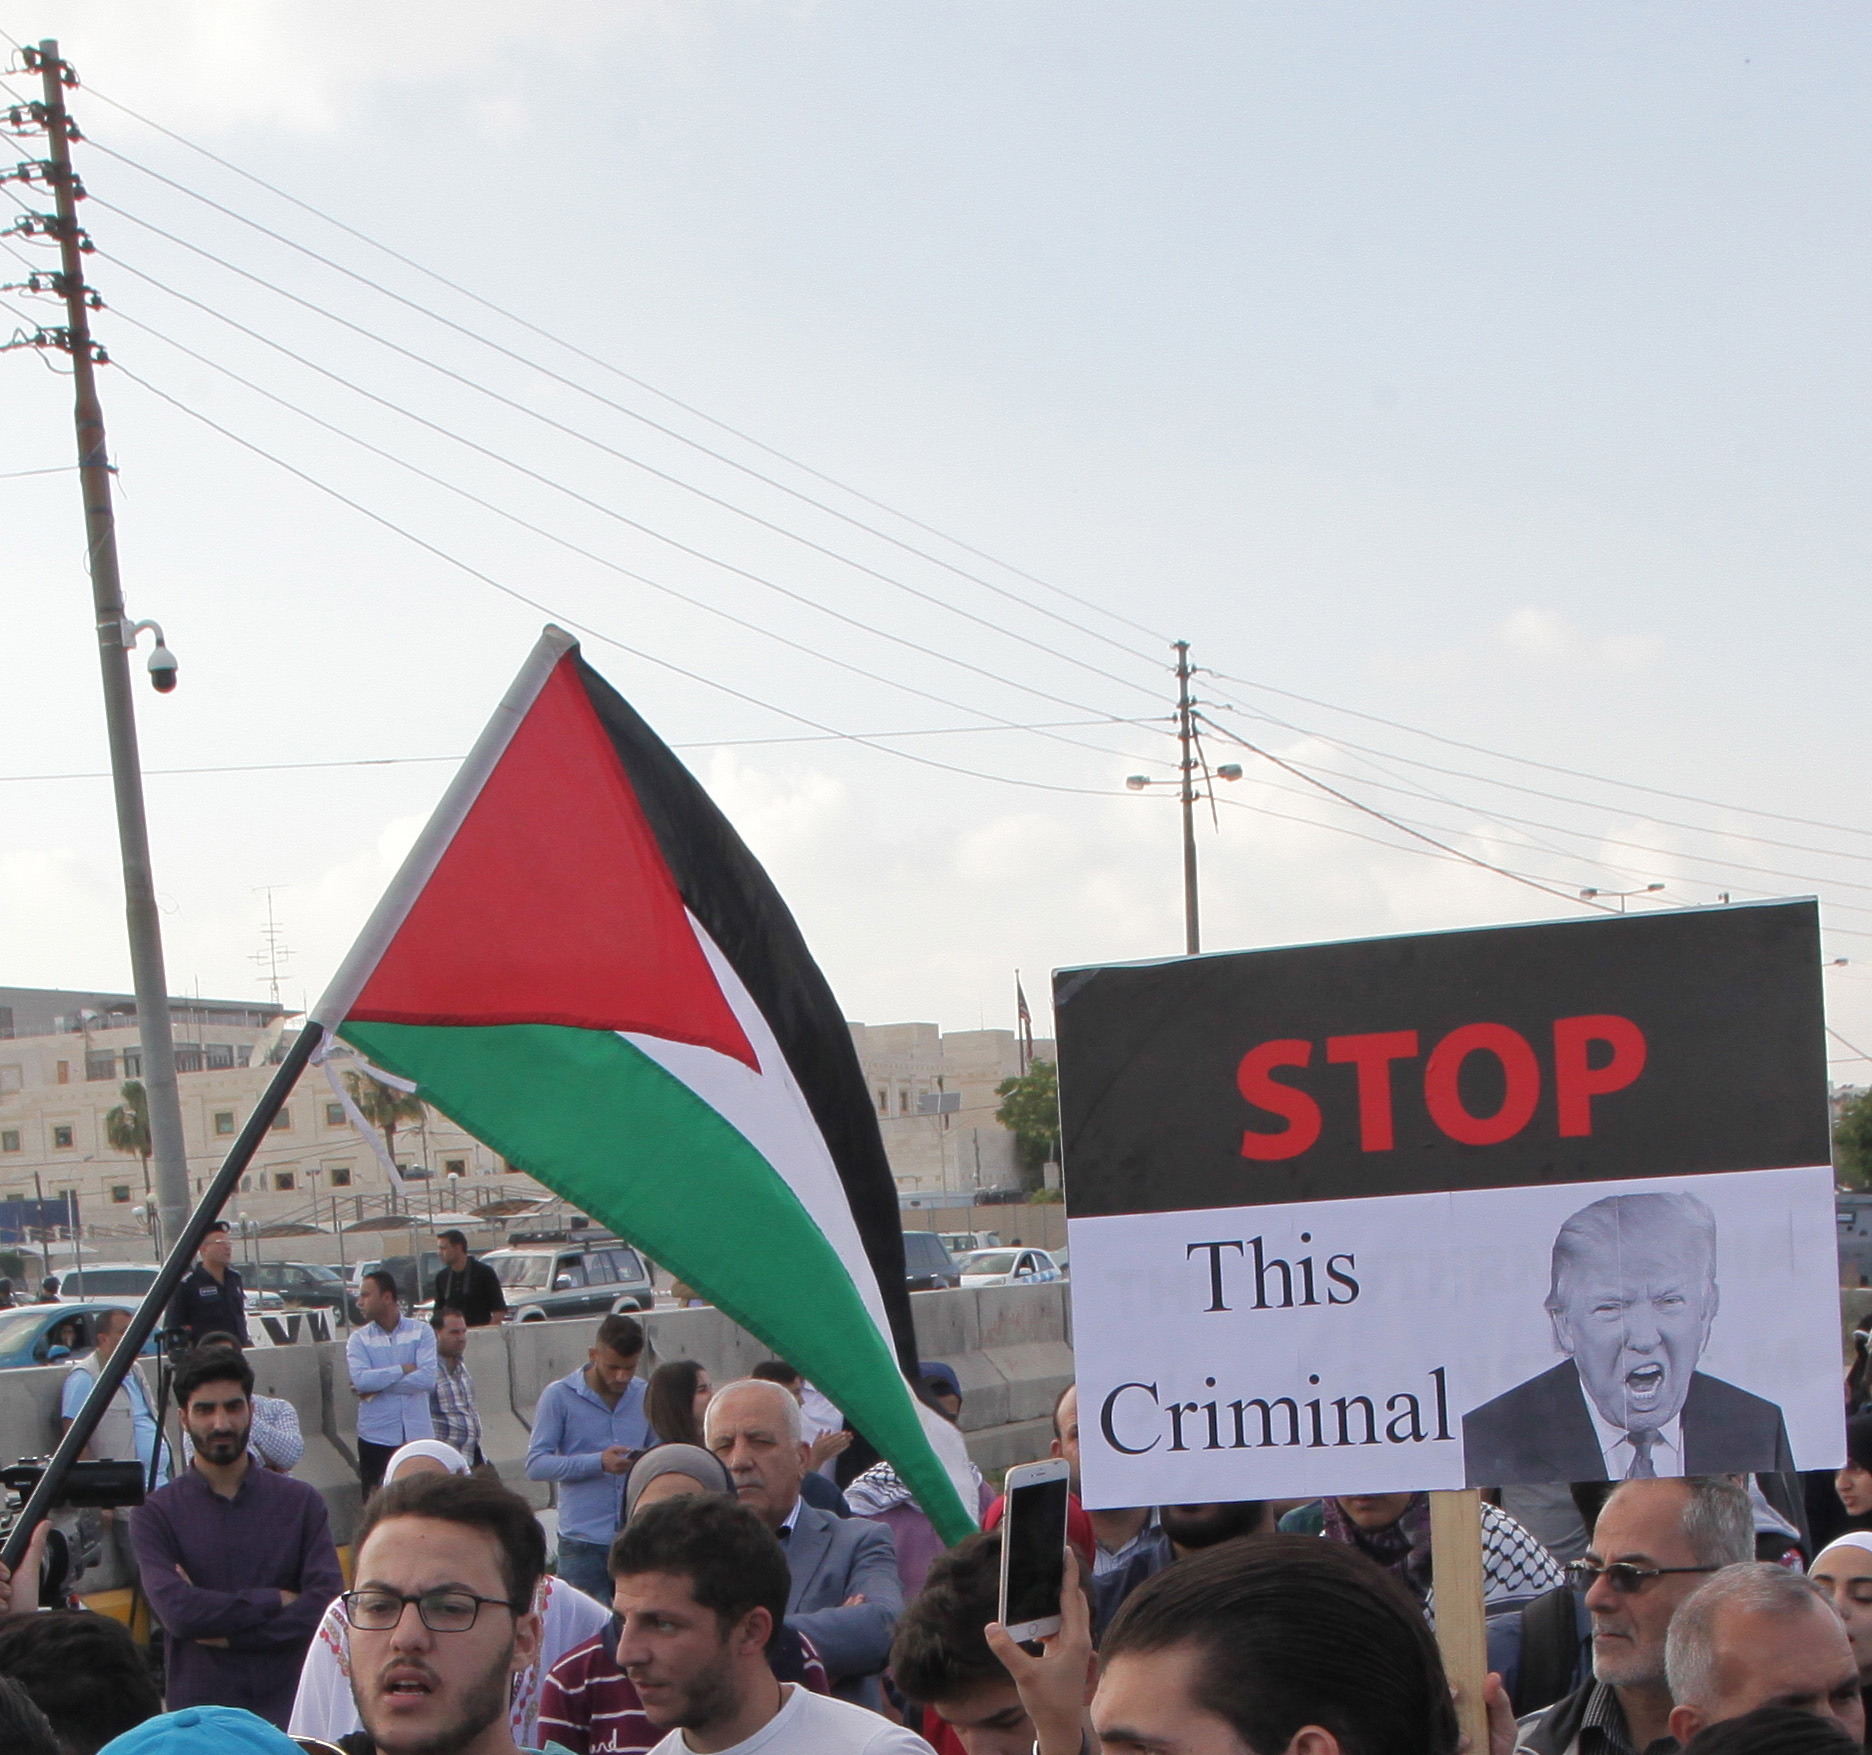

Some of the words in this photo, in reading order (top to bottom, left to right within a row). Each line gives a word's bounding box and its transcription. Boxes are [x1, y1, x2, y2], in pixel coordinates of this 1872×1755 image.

[1235, 1013, 1648, 1162] STOP
[1186, 1231, 1361, 1313] This
[1099, 1367, 1456, 1456] Criminal
